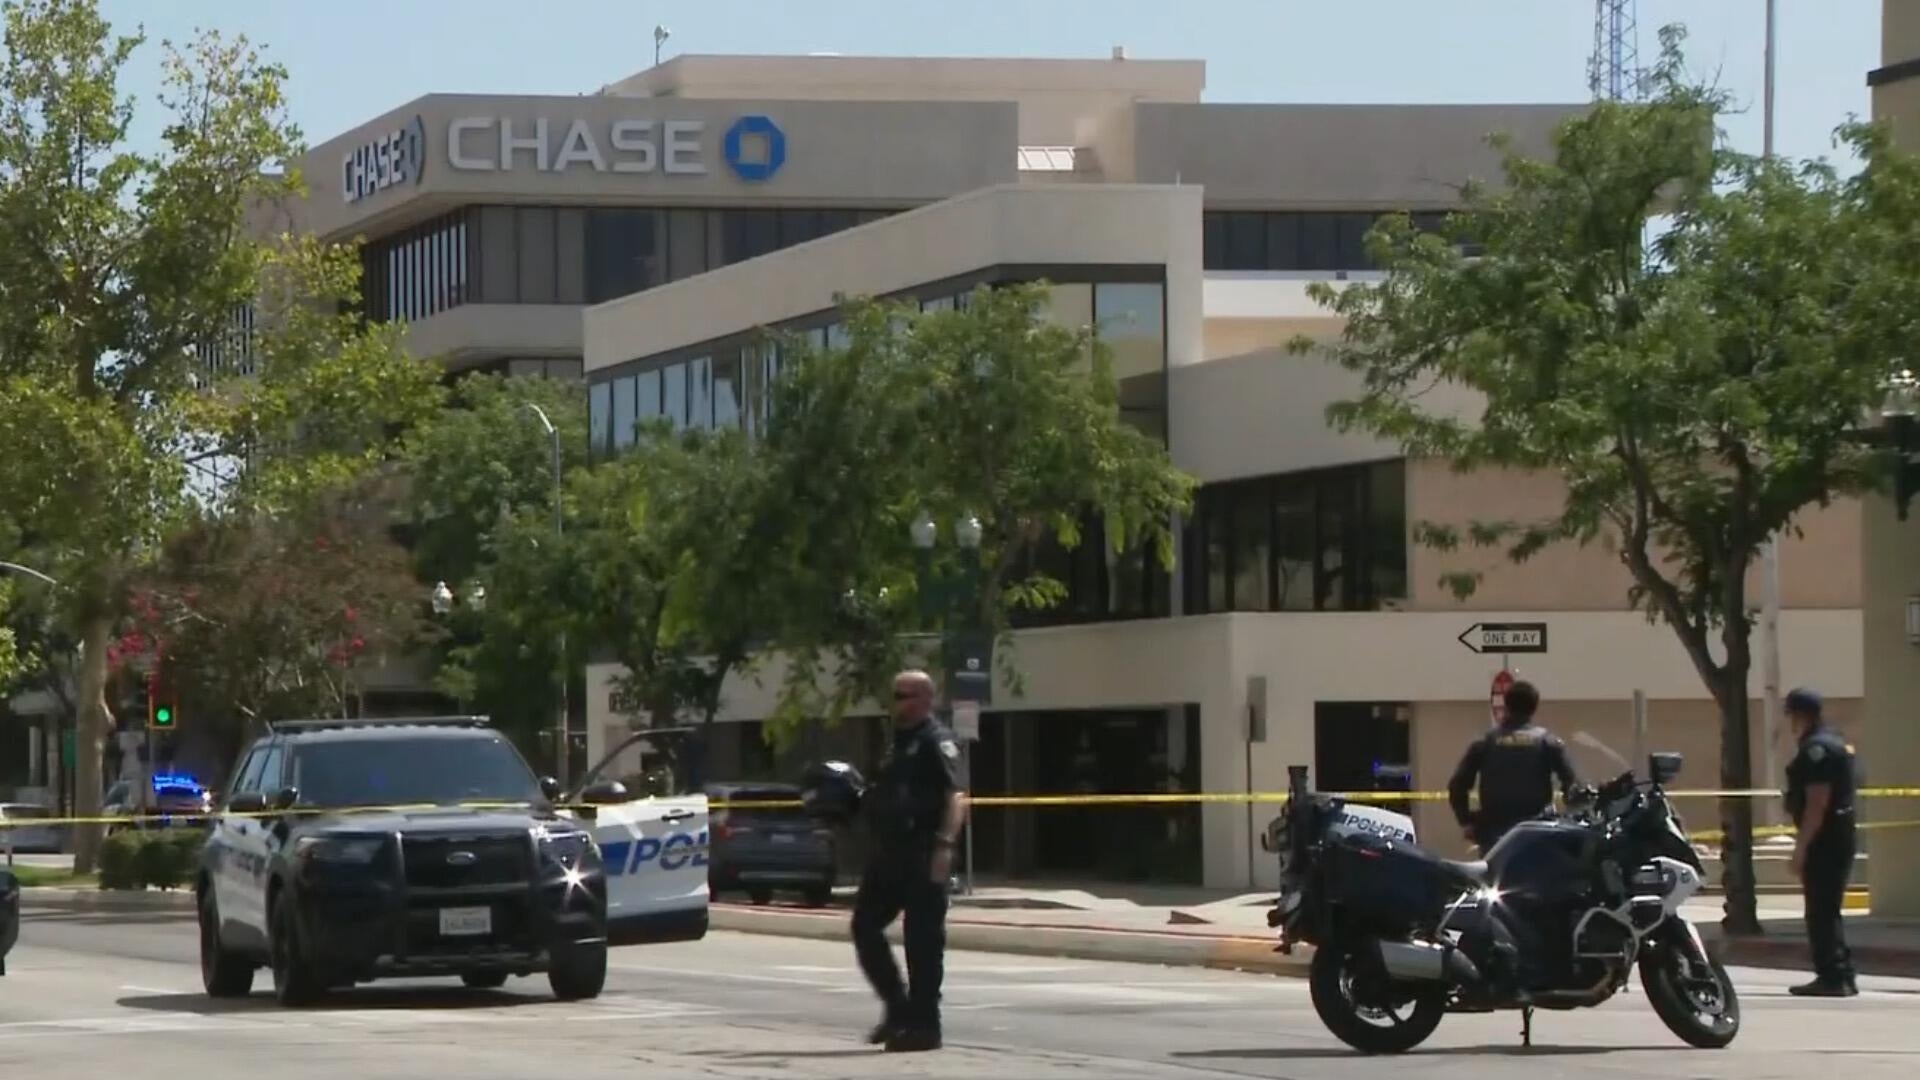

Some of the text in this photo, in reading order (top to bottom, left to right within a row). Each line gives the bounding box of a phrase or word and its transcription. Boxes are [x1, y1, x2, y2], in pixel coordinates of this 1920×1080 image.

[447, 116, 708, 174] CHASE
[343, 130, 405, 203] CHASE
[1482, 631, 1537, 645] ONE WAY
[1345, 813, 1405, 839] POLICE
